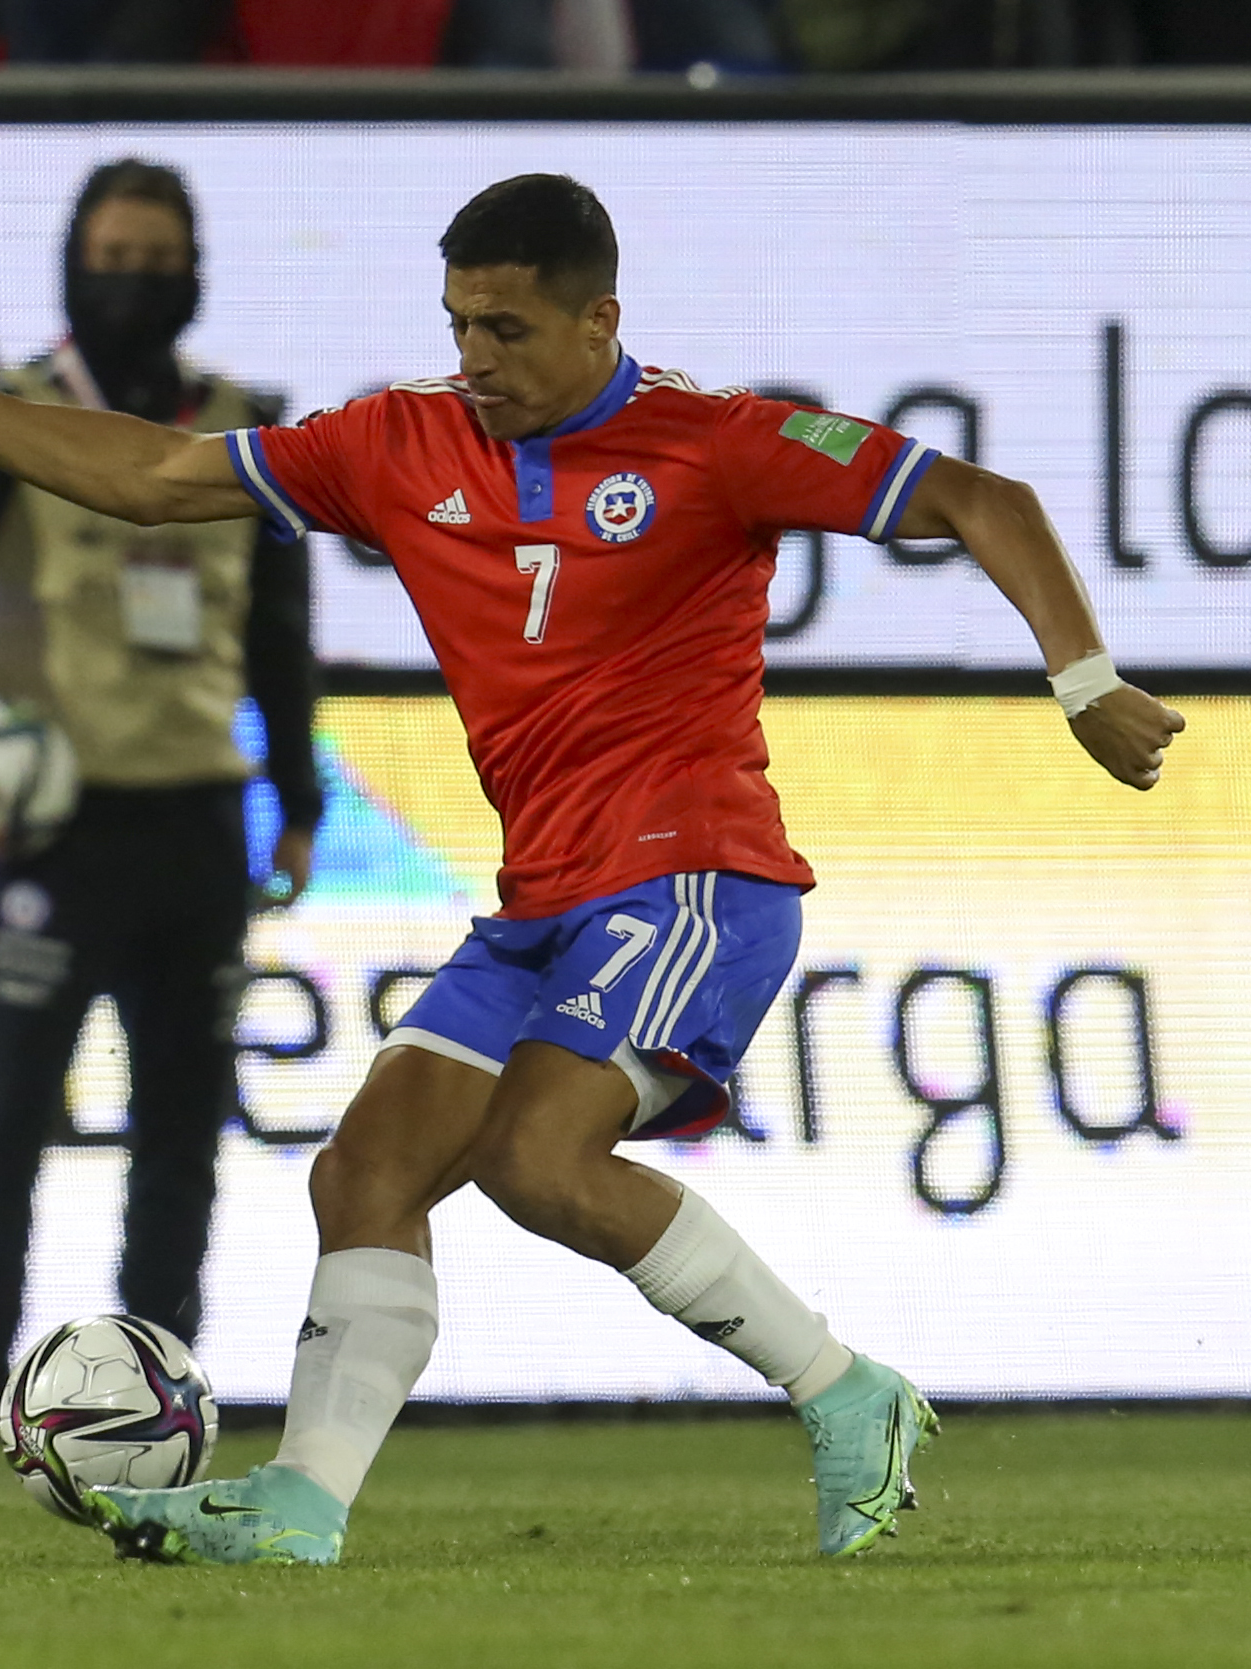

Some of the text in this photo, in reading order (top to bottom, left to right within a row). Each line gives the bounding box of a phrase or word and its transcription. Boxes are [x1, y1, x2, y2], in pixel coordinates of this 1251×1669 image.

[428, 509, 471, 524] adidas
[514, 543, 560, 645] 7
[589, 914, 657, 993] 7
[556, 1003, 607, 1030] adidas
